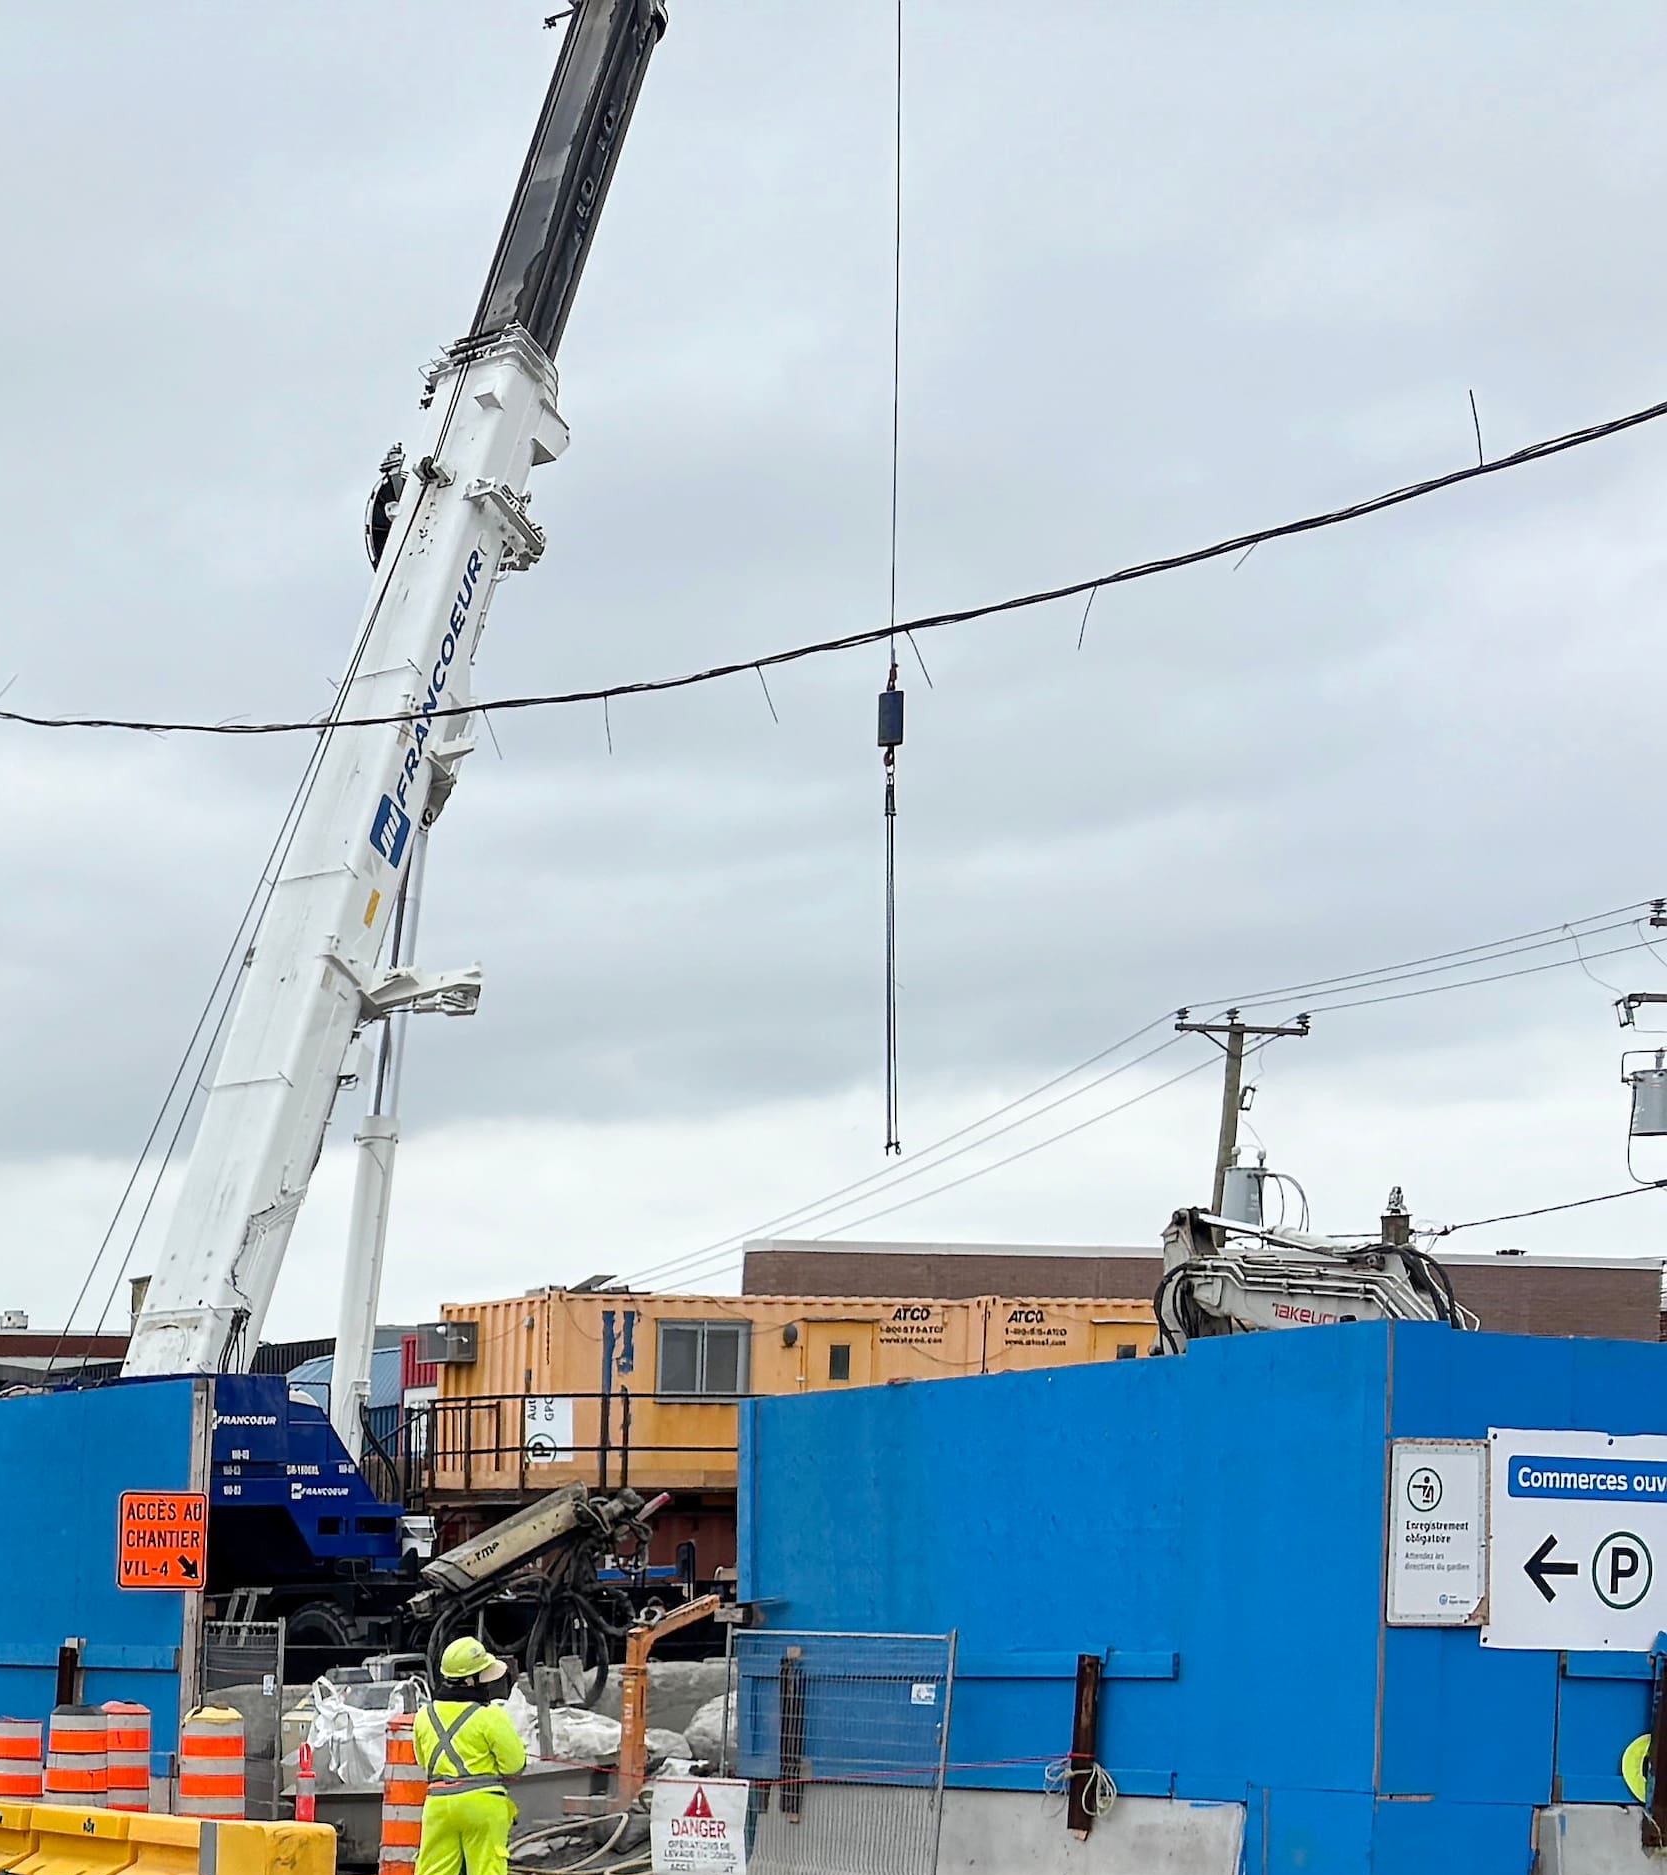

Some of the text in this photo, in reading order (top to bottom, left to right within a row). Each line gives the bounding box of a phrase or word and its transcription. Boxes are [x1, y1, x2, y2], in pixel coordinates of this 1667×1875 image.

[395, 549, 483, 810] FRANCOEUR
[892, 1307, 931, 1320] ATCO
[1008, 1310, 1044, 1323] ATCO
[218, 1415, 277, 1425] FRANCOEUR
[1518, 1467, 1627, 1491] Commerces
[127, 1499, 202, 1521] ACCÈS AU
[1405, 1520, 1468, 1532] Enregistrement
[126, 1530, 200, 1548] CHANTIER
[1405, 1533, 1451, 1545] obligatoire
[124, 1561, 168, 1576] VIL-4
[672, 1819, 726, 1838] DANGER
